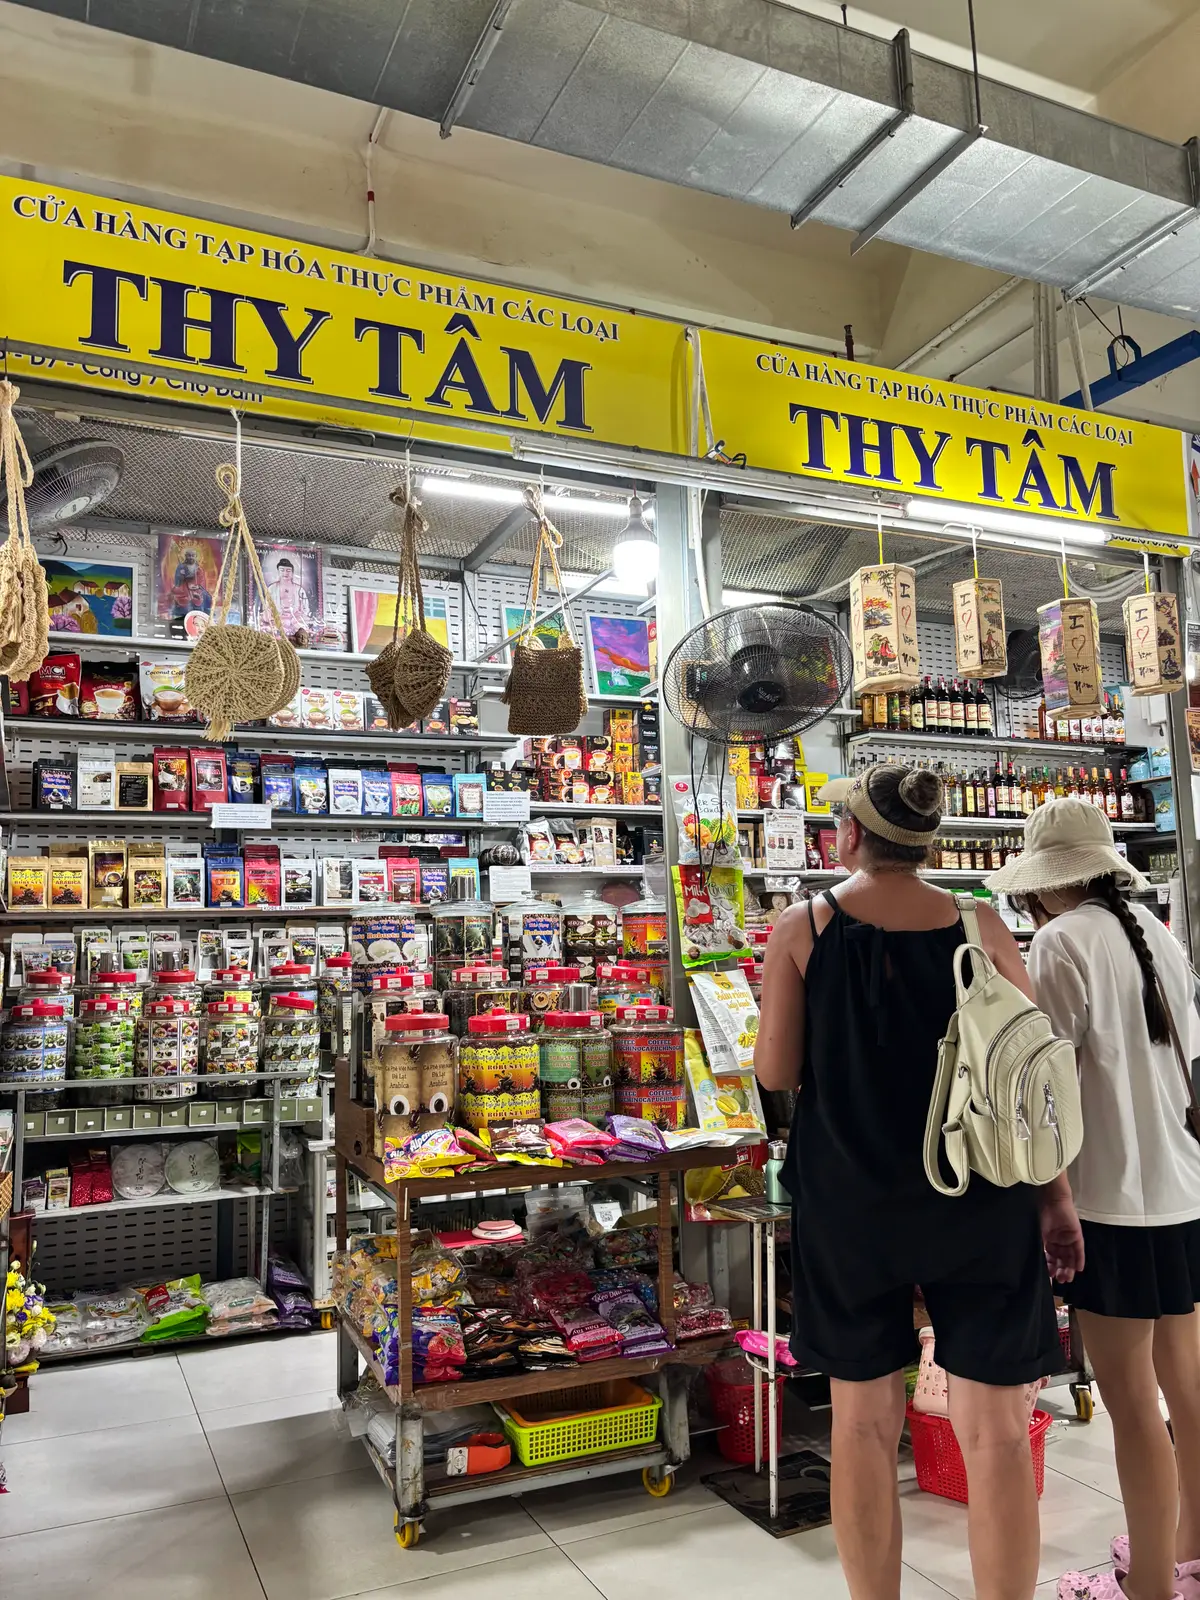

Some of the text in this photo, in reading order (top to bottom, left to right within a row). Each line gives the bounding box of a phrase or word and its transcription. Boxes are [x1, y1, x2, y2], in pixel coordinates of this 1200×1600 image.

[13, 194, 621, 342] CỬA HÀNG TẠP HÓA THỰC PHẨM CÁC LOẠI
[63, 260, 595, 433] THY TÂM
[756, 353, 1133, 447] CỬA HÀNG TẠP HÓA THỰC PHẨM CÁC LOẠI
[789, 403, 1121, 521] THY TÂM
[1068, 614, 1084, 630] I
[1135, 608, 1148, 623] I
